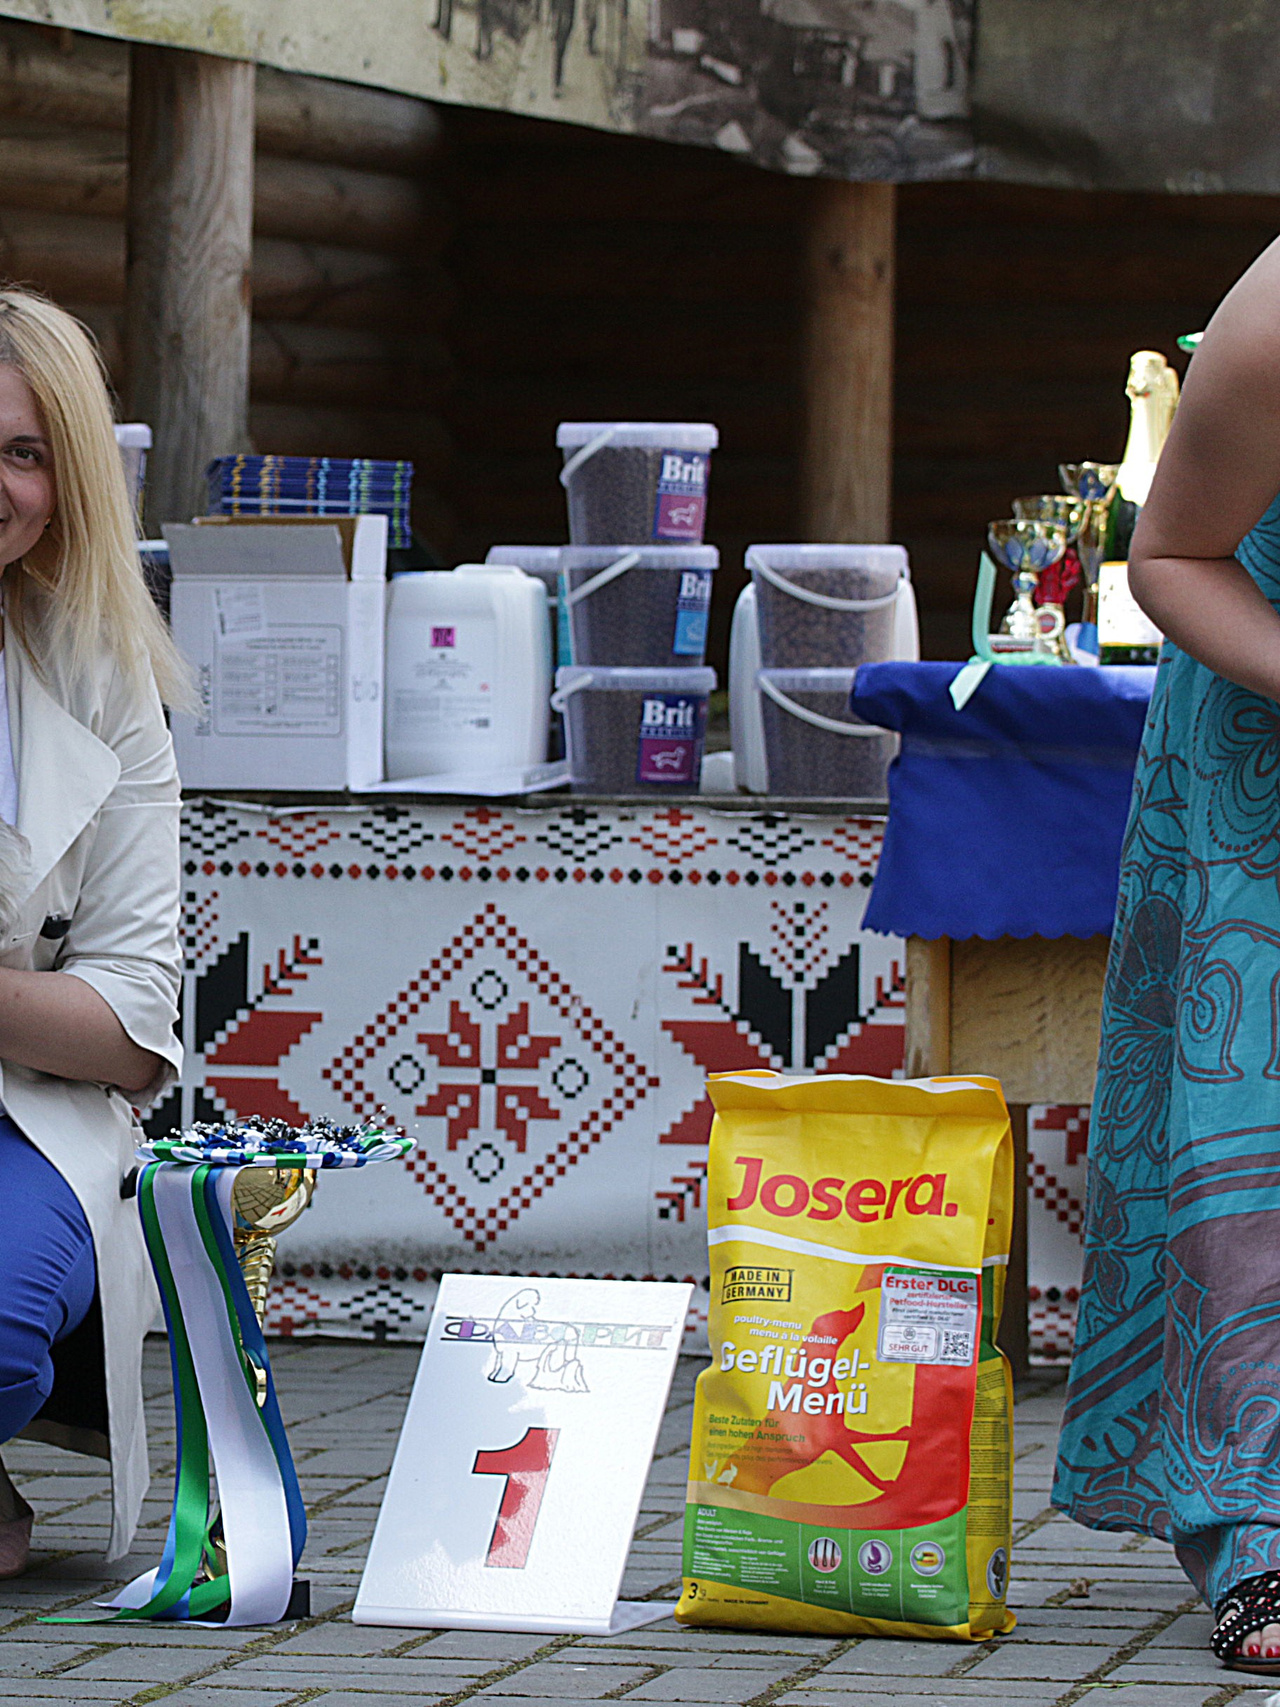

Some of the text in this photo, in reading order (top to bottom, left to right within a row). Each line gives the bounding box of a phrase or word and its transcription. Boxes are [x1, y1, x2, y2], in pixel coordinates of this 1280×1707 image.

[661, 454, 705, 486] Brit
[642, 699, 694, 728] Brit
[726, 1155, 958, 1224] Josera.
[730, 1270, 780, 1282] MADE IN
[885, 1275, 974, 1293] Erster DLG-
[726, 1286, 785, 1299] GERMANY
[734, 1314, 802, 1330] poultry-menu
[749, 1327, 778, 1339] menu
[790, 1331, 800, 1341] la
[802, 1333, 838, 1345] volaille
[720, 1340, 870, 1388] Geflügel-
[766, 1380, 868, 1415] Menü
[765, 1418, 779, 1428] für
[728, 1428, 754, 1440] hohen
[756, 1430, 806, 1443] Anspruch
[471, 1426, 561, 1570] 1
[688, 1582, 698, 1600] 3
